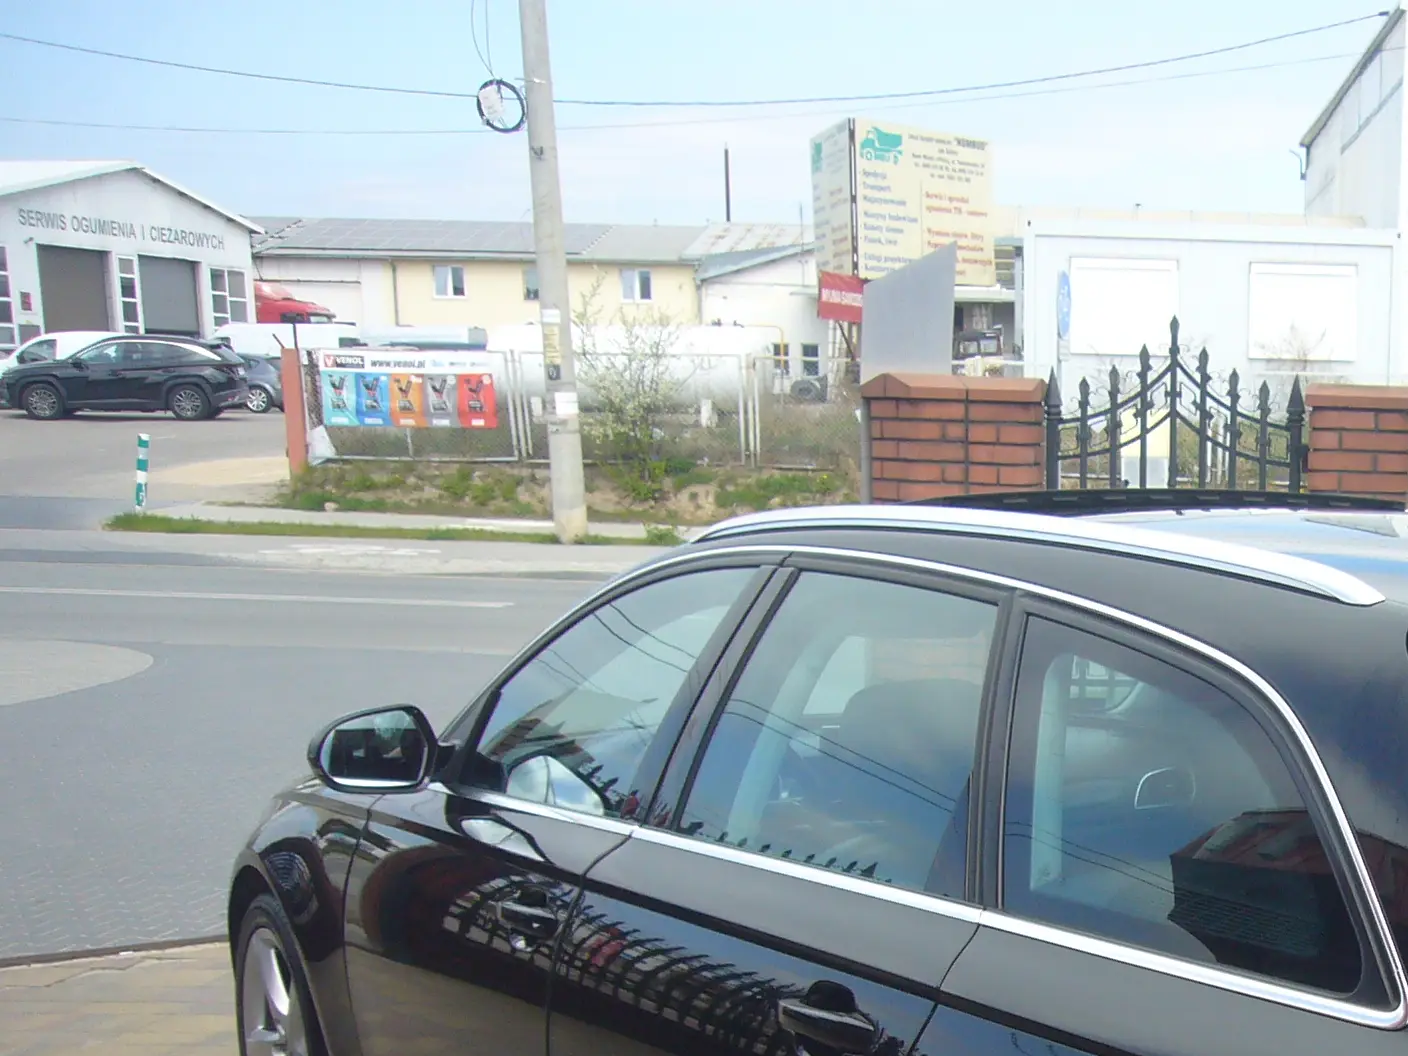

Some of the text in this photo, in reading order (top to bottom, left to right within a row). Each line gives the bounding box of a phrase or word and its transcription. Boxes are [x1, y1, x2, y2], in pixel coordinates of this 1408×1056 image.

[18, 208, 67, 231] SERWIS
[71, 216, 137, 239] OGUMIENIA
[336, 356, 364, 365] VENOL
